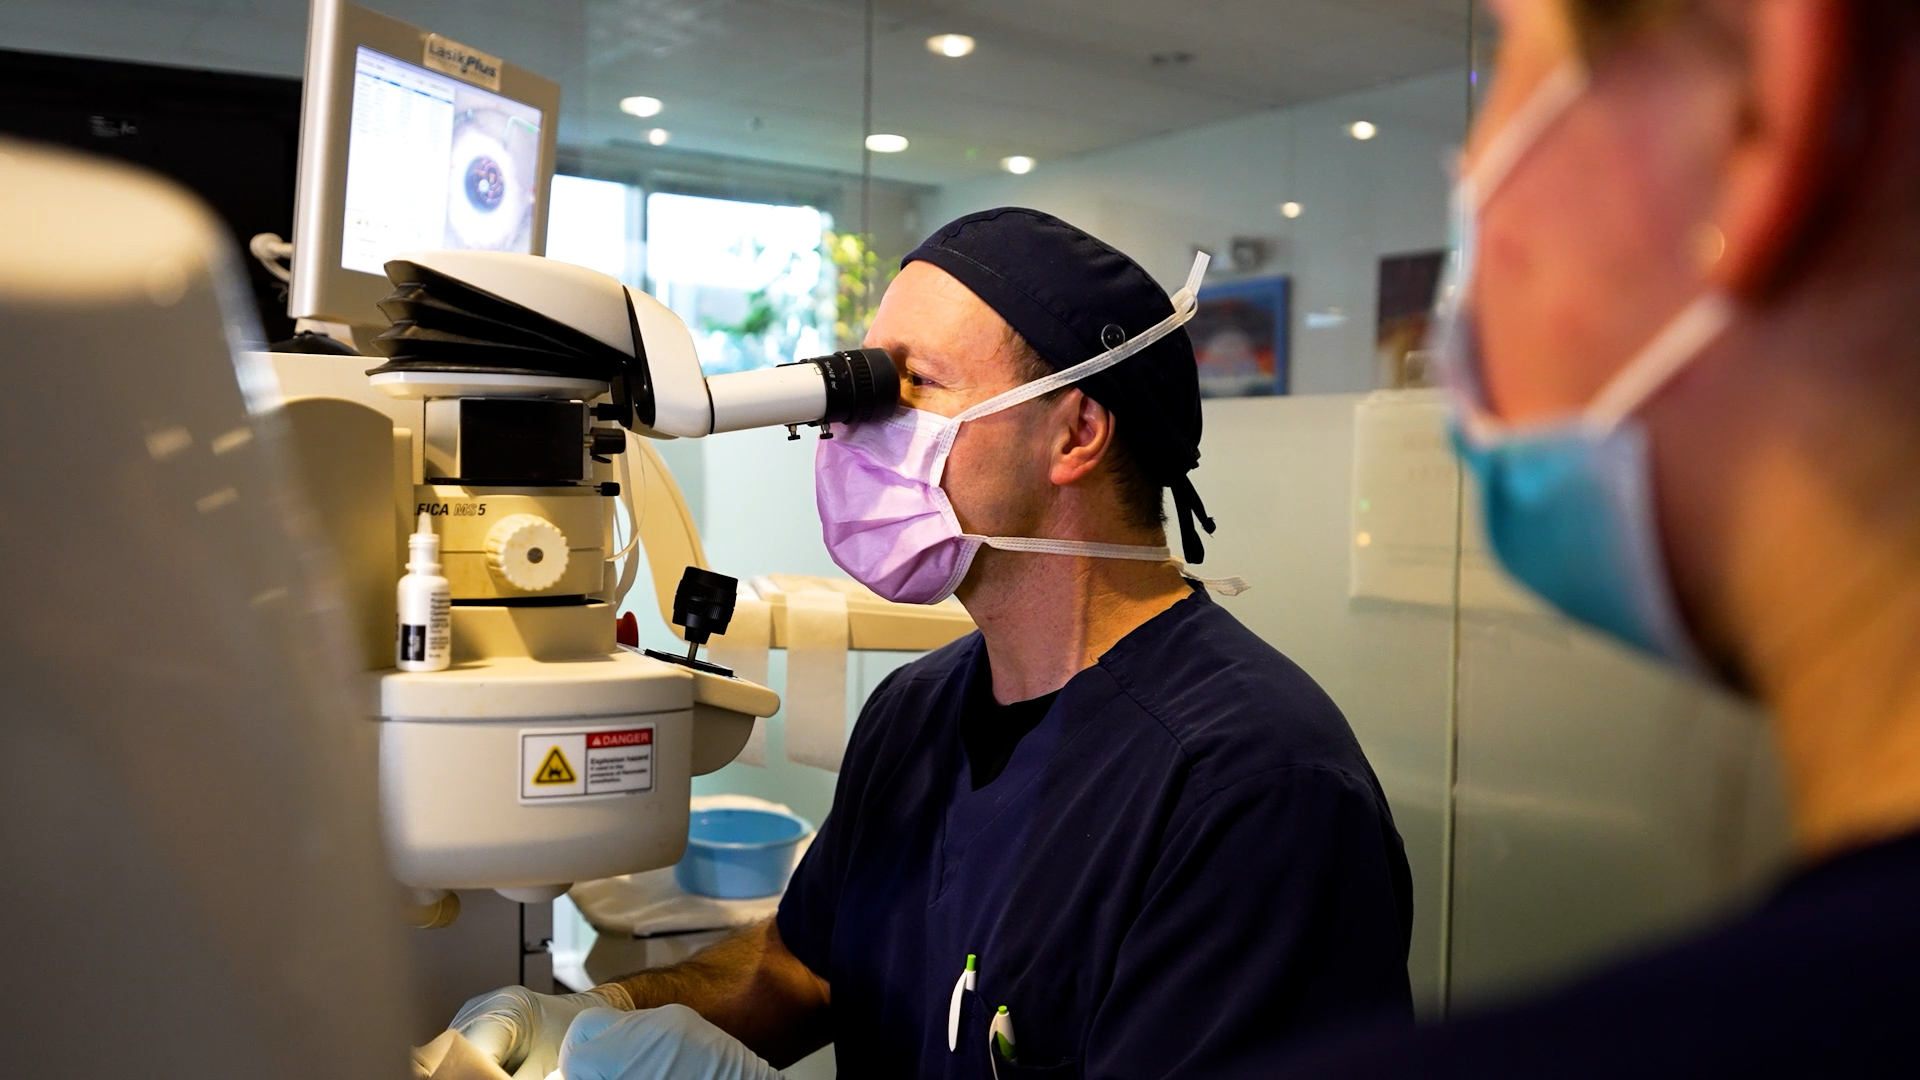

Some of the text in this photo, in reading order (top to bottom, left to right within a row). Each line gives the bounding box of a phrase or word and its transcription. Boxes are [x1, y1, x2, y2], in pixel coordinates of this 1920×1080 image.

[428, 40, 497, 77] LasikPlus
[414, 503, 449, 516] EICA
[602, 732, 649, 746] DANGER
